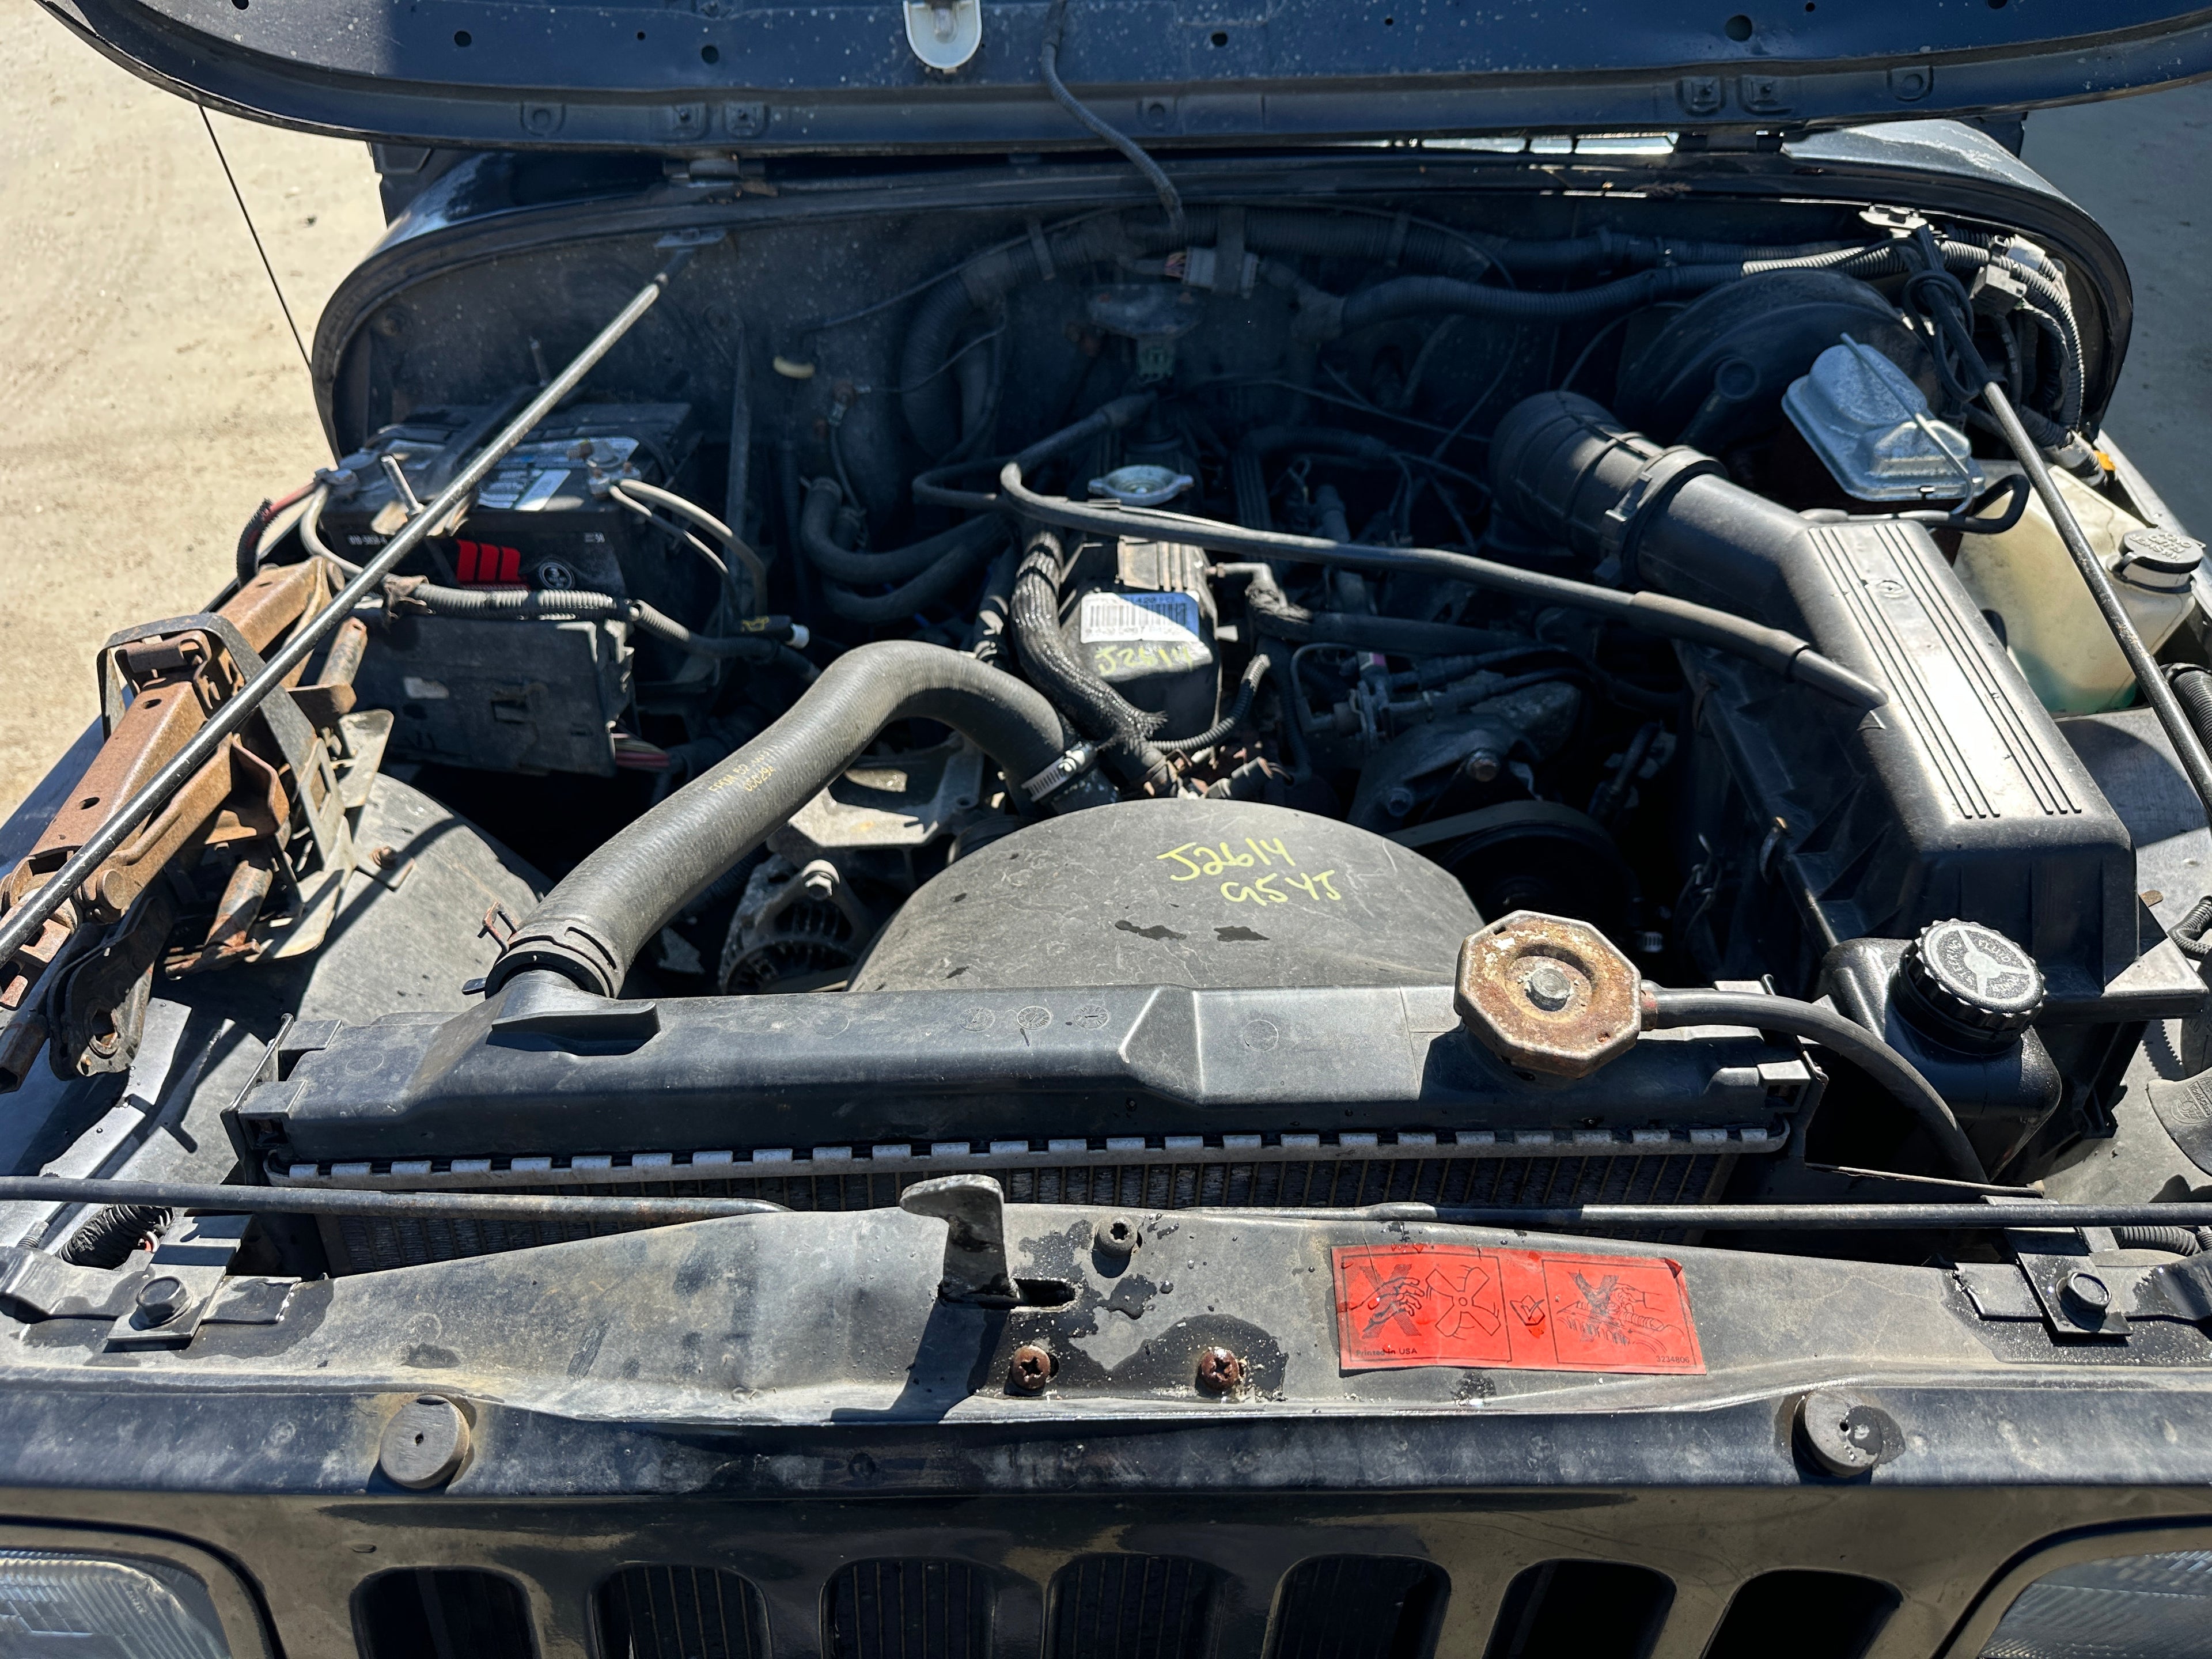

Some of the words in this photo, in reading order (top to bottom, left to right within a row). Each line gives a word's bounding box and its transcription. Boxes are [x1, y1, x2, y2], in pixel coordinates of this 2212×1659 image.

[1156, 838, 1296, 881] J2614
[1946, 939, 1975, 986] STEERING
[1978, 940, 2011, 962] FLUID
[1355, 1347, 1385, 1356] Printed
[1656, 1355, 1690, 1363] 3234806
